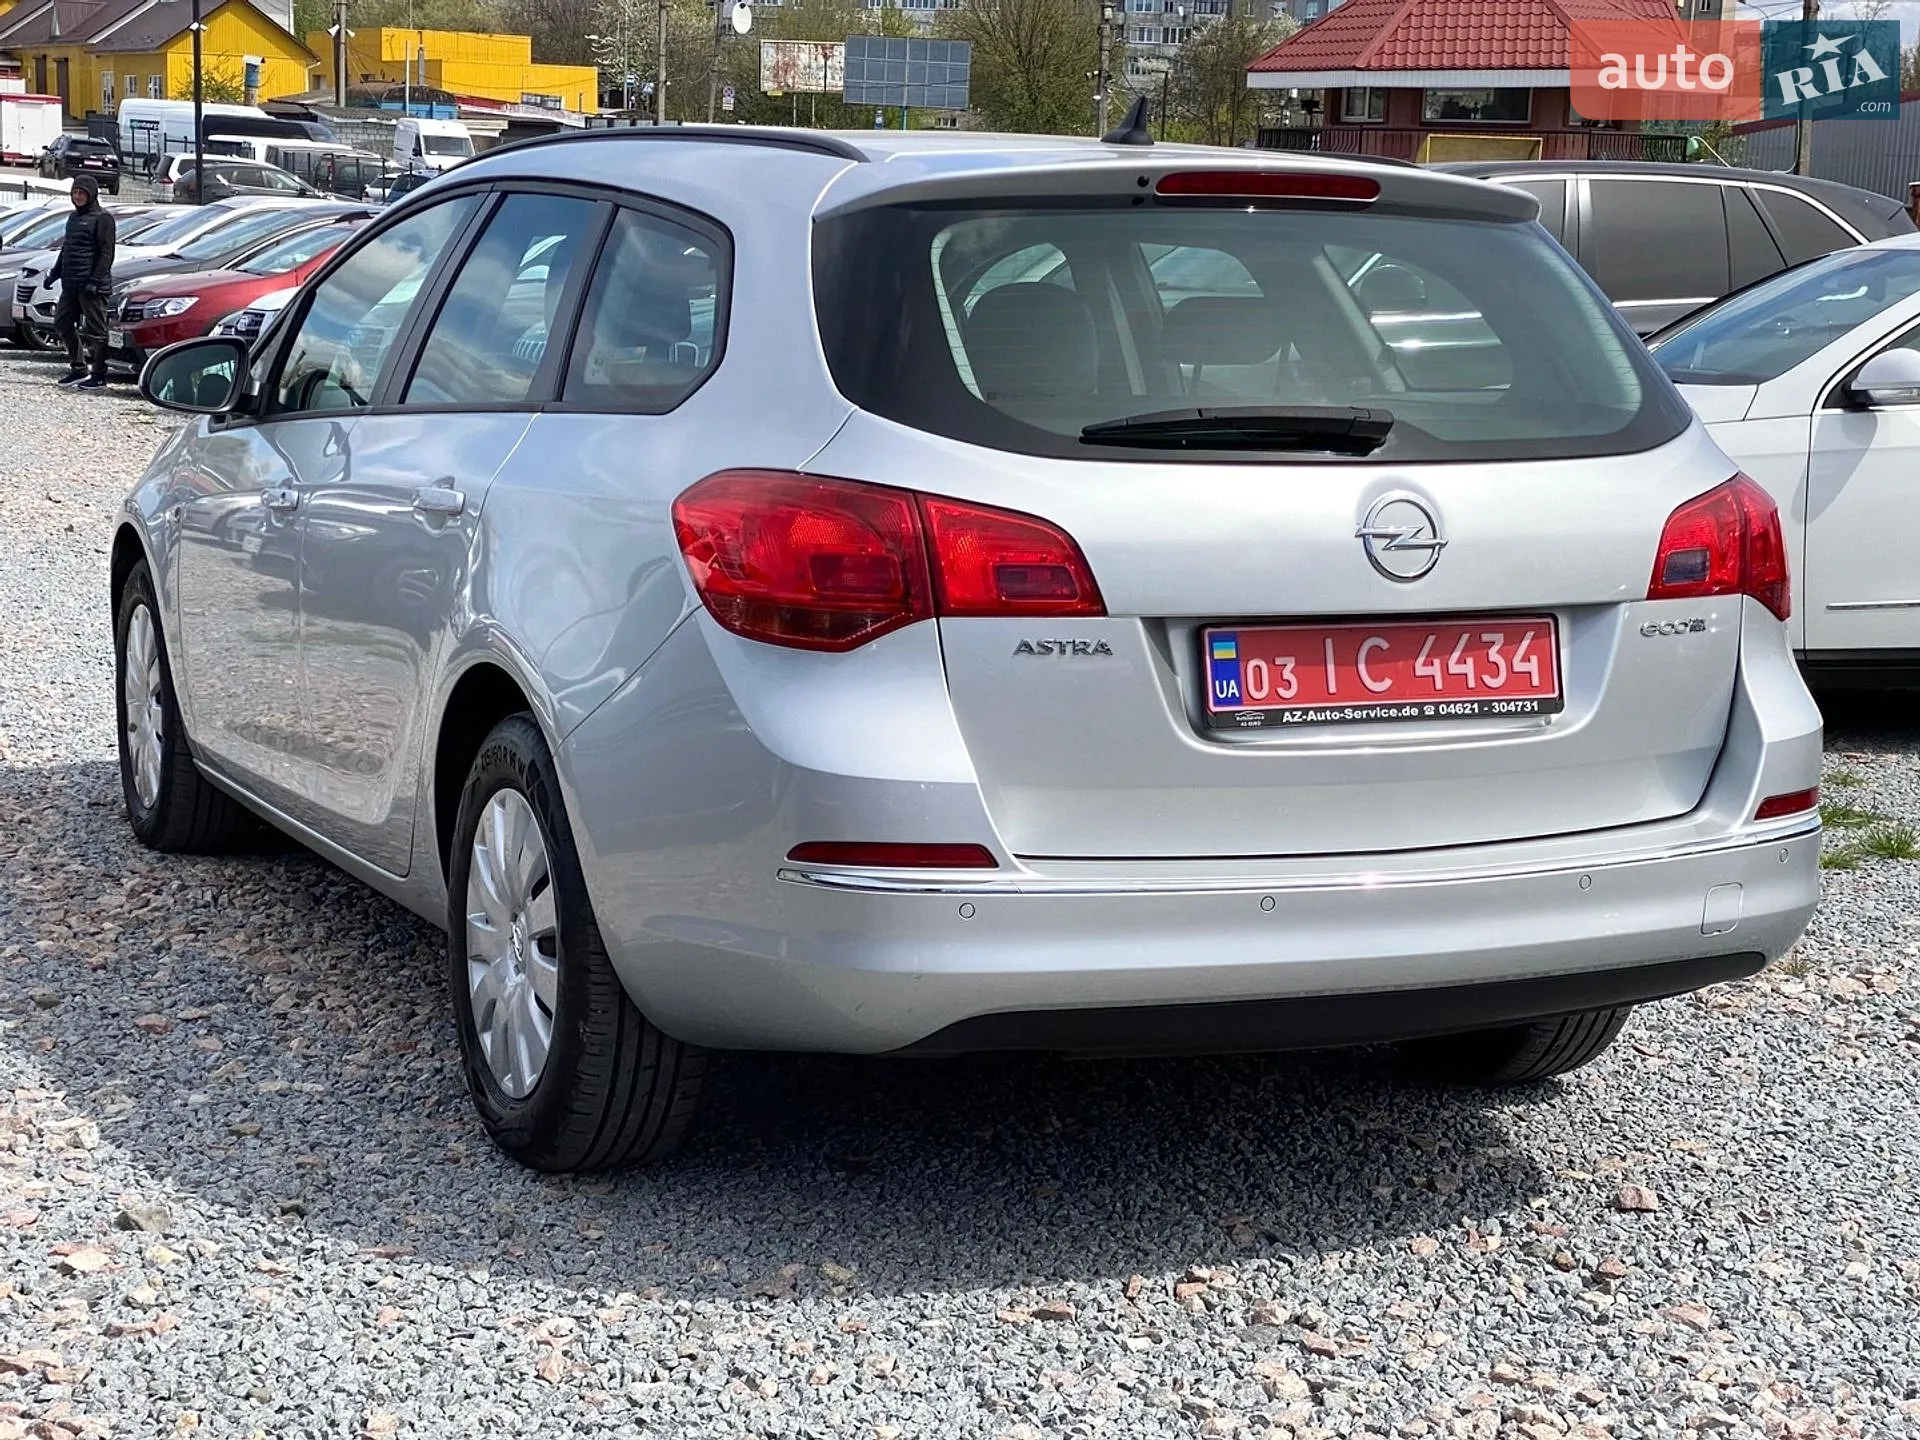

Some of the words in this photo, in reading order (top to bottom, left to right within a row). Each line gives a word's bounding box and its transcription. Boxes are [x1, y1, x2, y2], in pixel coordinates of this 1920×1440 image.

[1012, 638, 1115, 657] ASTRA
[1245, 656, 1299, 701] 03
[1414, 629, 1541, 691] 4434
[1215, 679, 1240, 699] UA
[1282, 705, 1420, 723] AZ-Auto-Service.de
[1438, 702, 1480, 715] 04621
[1491, 700, 1539, 713] 304731
